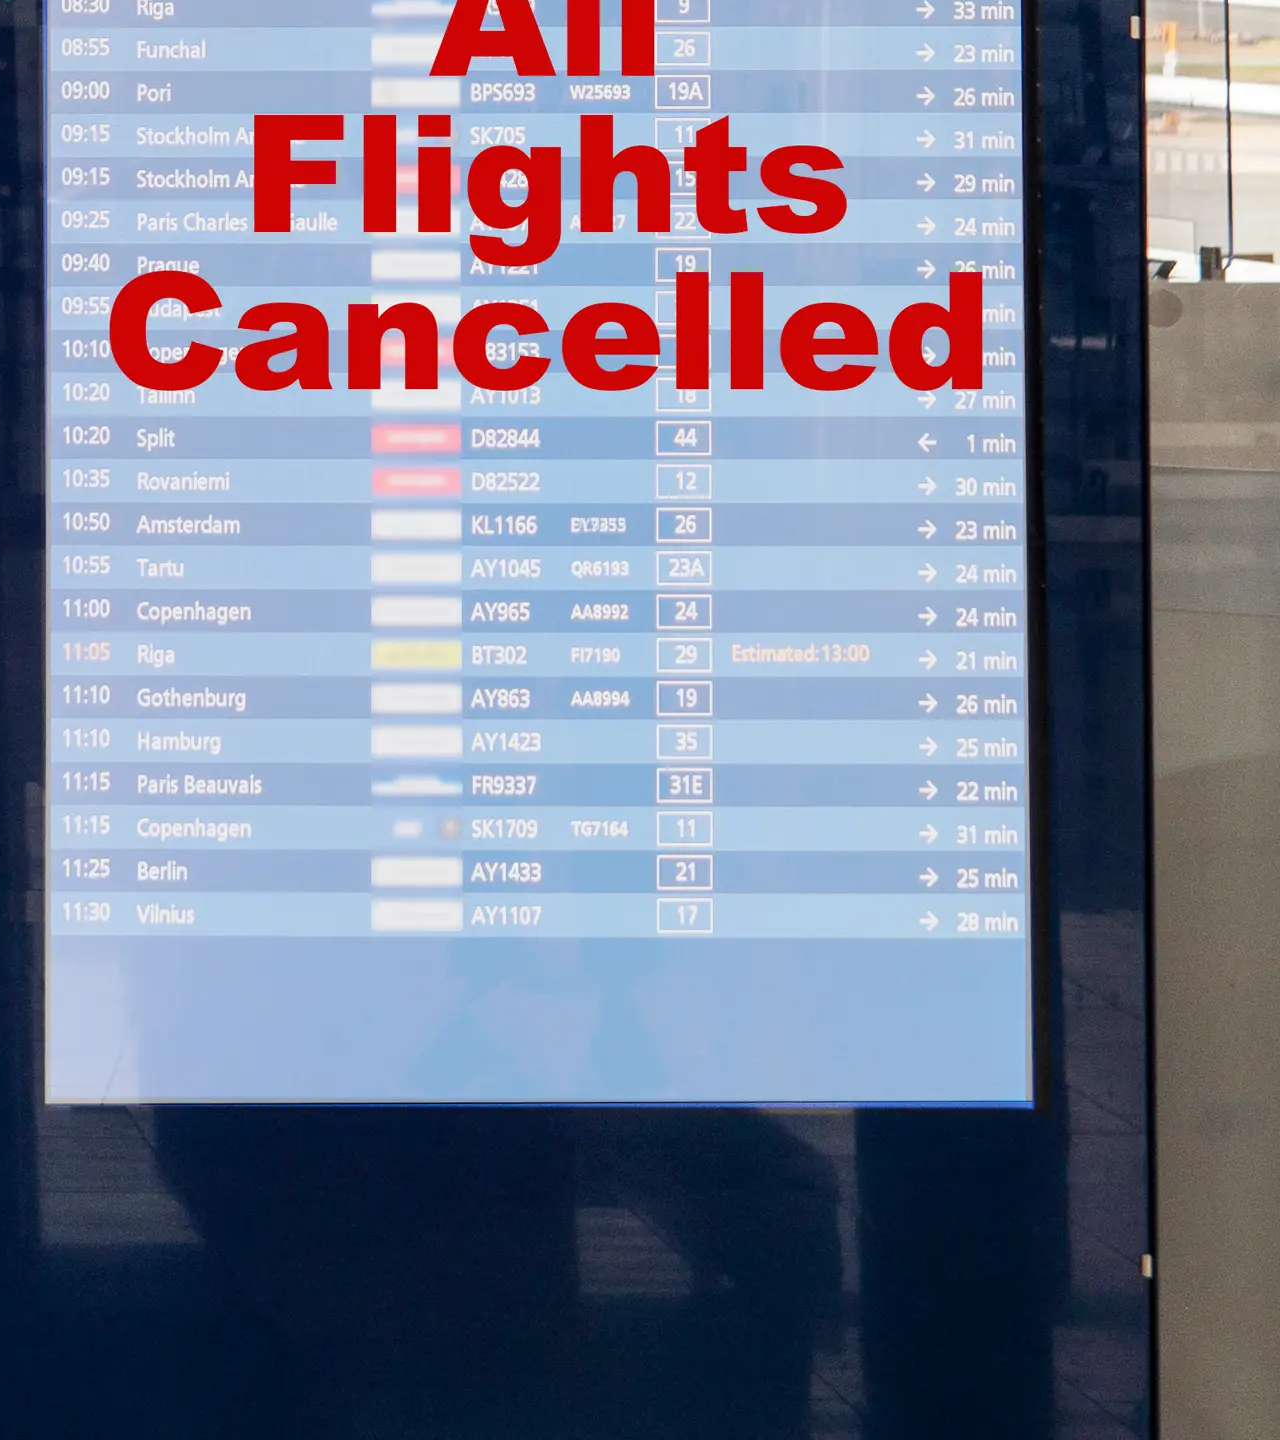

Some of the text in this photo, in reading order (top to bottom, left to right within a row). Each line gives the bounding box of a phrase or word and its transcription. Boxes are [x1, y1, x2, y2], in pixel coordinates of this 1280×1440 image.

[62, 425, 111, 446] 10:20
[136, 427, 176, 452] Split
[471, 428, 541, 449] D82844
[673, 427, 698, 447] 44
[982, 432, 1016, 454] min
[62, 598, 1017, 628] 11:00 Copenhagen AY965 AA8992 24 24 min
[63, 641, 111, 662] 11:05
[137, 642, 175, 669] Riga
[471, 644, 527, 666] BT302
[675, 644, 698, 665] 29
[955, 650, 976, 671] 21
[983, 650, 1018, 671] min
[62, 771, 1018, 802] 11:15 Paris Beauvais FR9337 31E 22 min
[62, 858, 1019, 889] 11:25 Berlin AY1433 21 25 min
